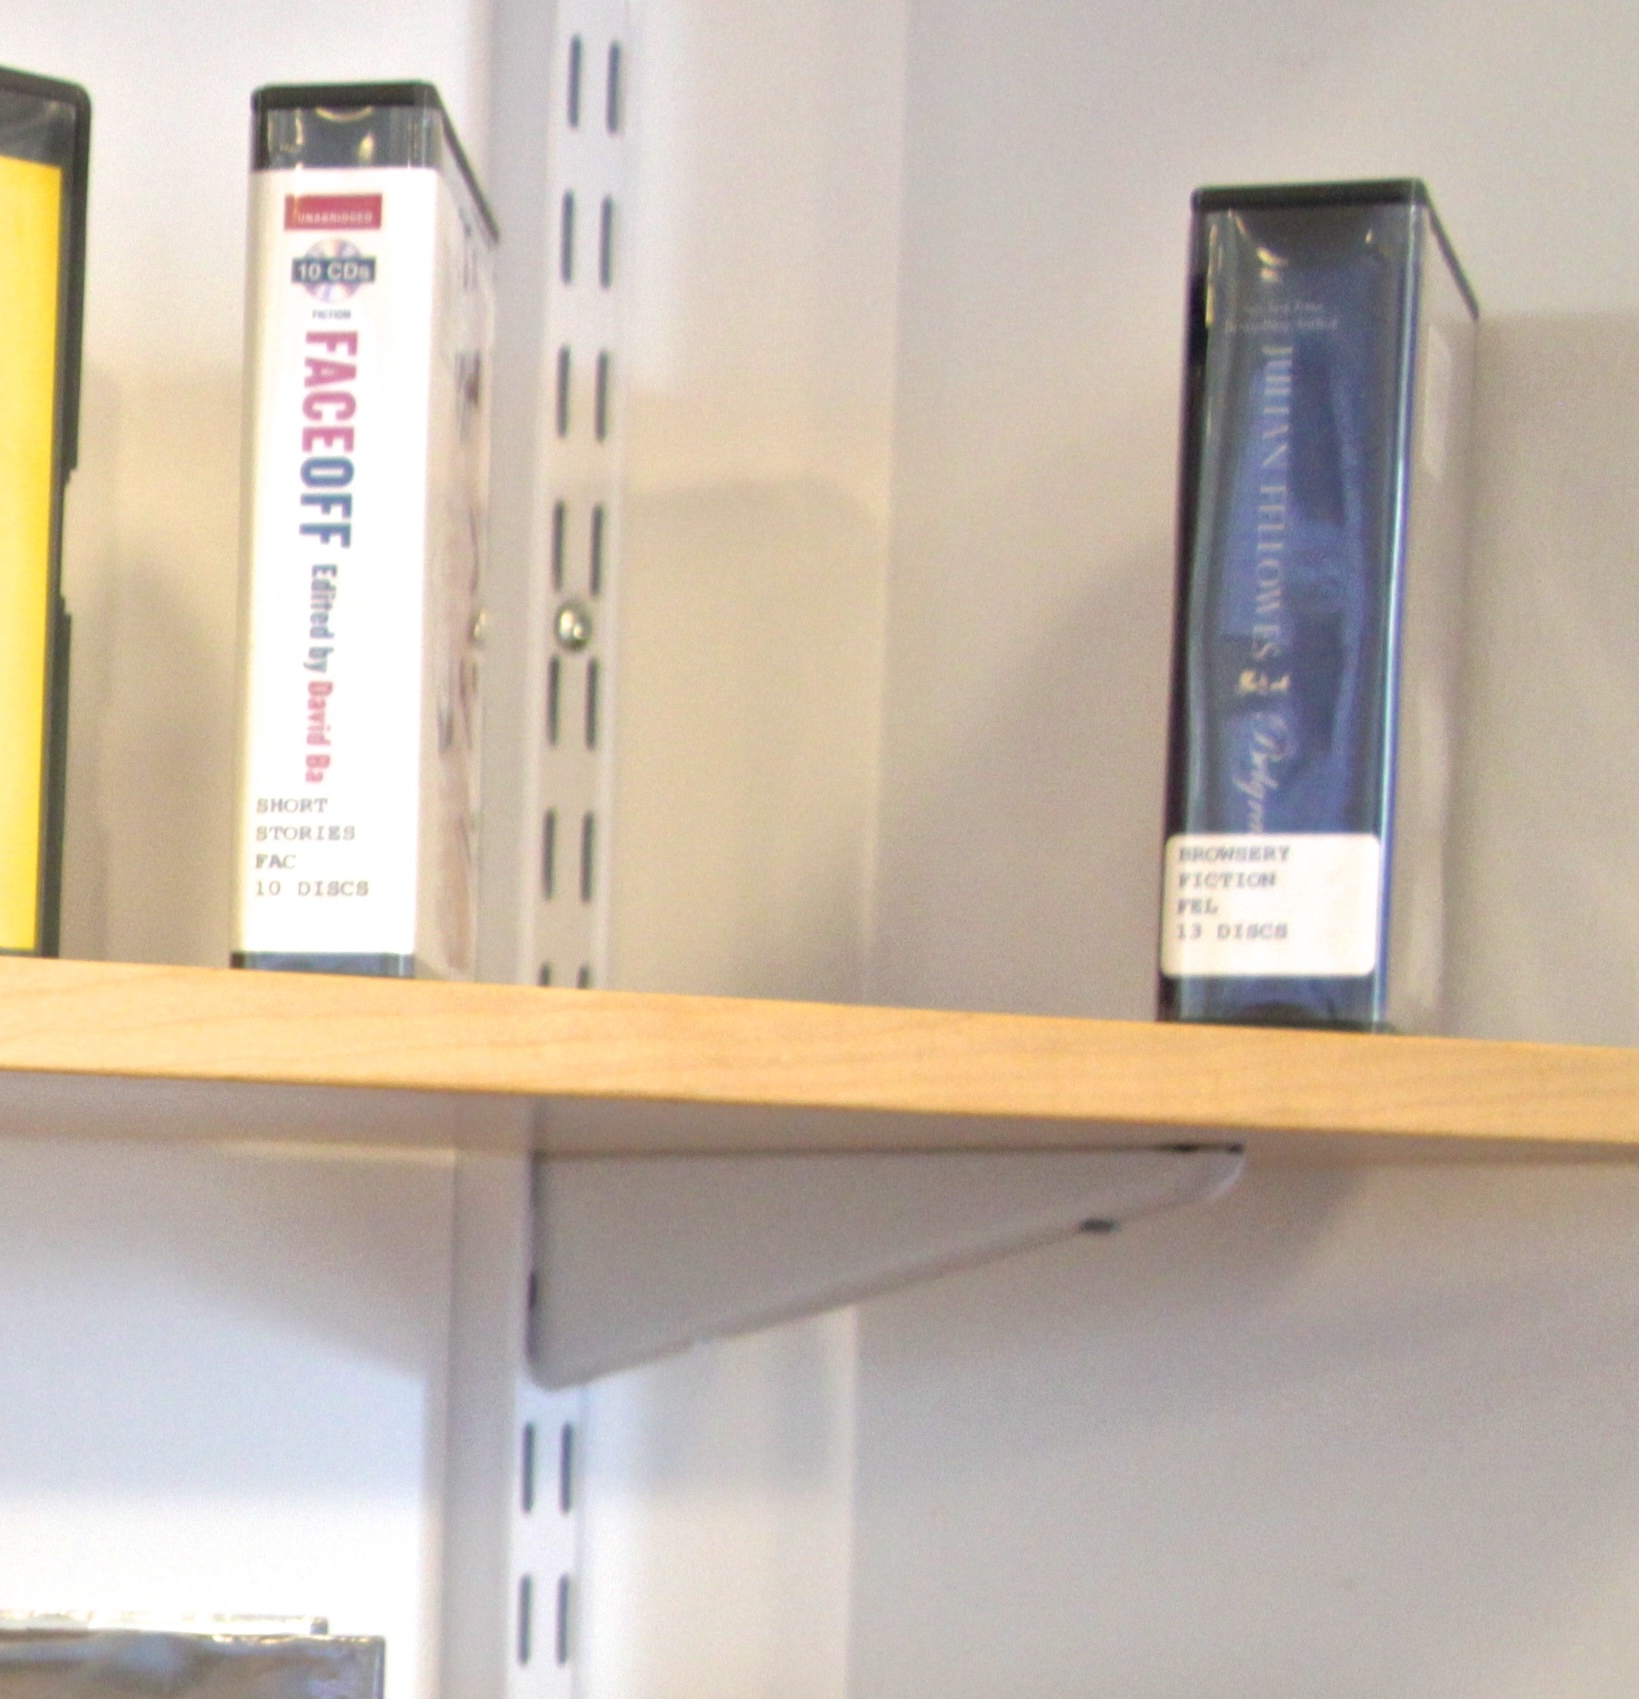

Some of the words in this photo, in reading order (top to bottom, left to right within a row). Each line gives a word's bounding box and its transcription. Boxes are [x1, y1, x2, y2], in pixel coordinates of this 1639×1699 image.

[297, 261, 322, 281] 10
[327, 260, 371, 281] CDs
[299, 330, 359, 550] FACEOFF
[309, 564, 339, 640] Edited
[303, 646, 335, 672] by
[305, 680, 334, 747] David
[256, 797, 329, 814] SHORT
[255, 825, 357, 842] STORIES
[255, 853, 297, 870] FAC
[255, 880, 281, 897] 10
[297, 880, 370, 897] DISCS
[1217, 923, 1288, 940] DISCS
